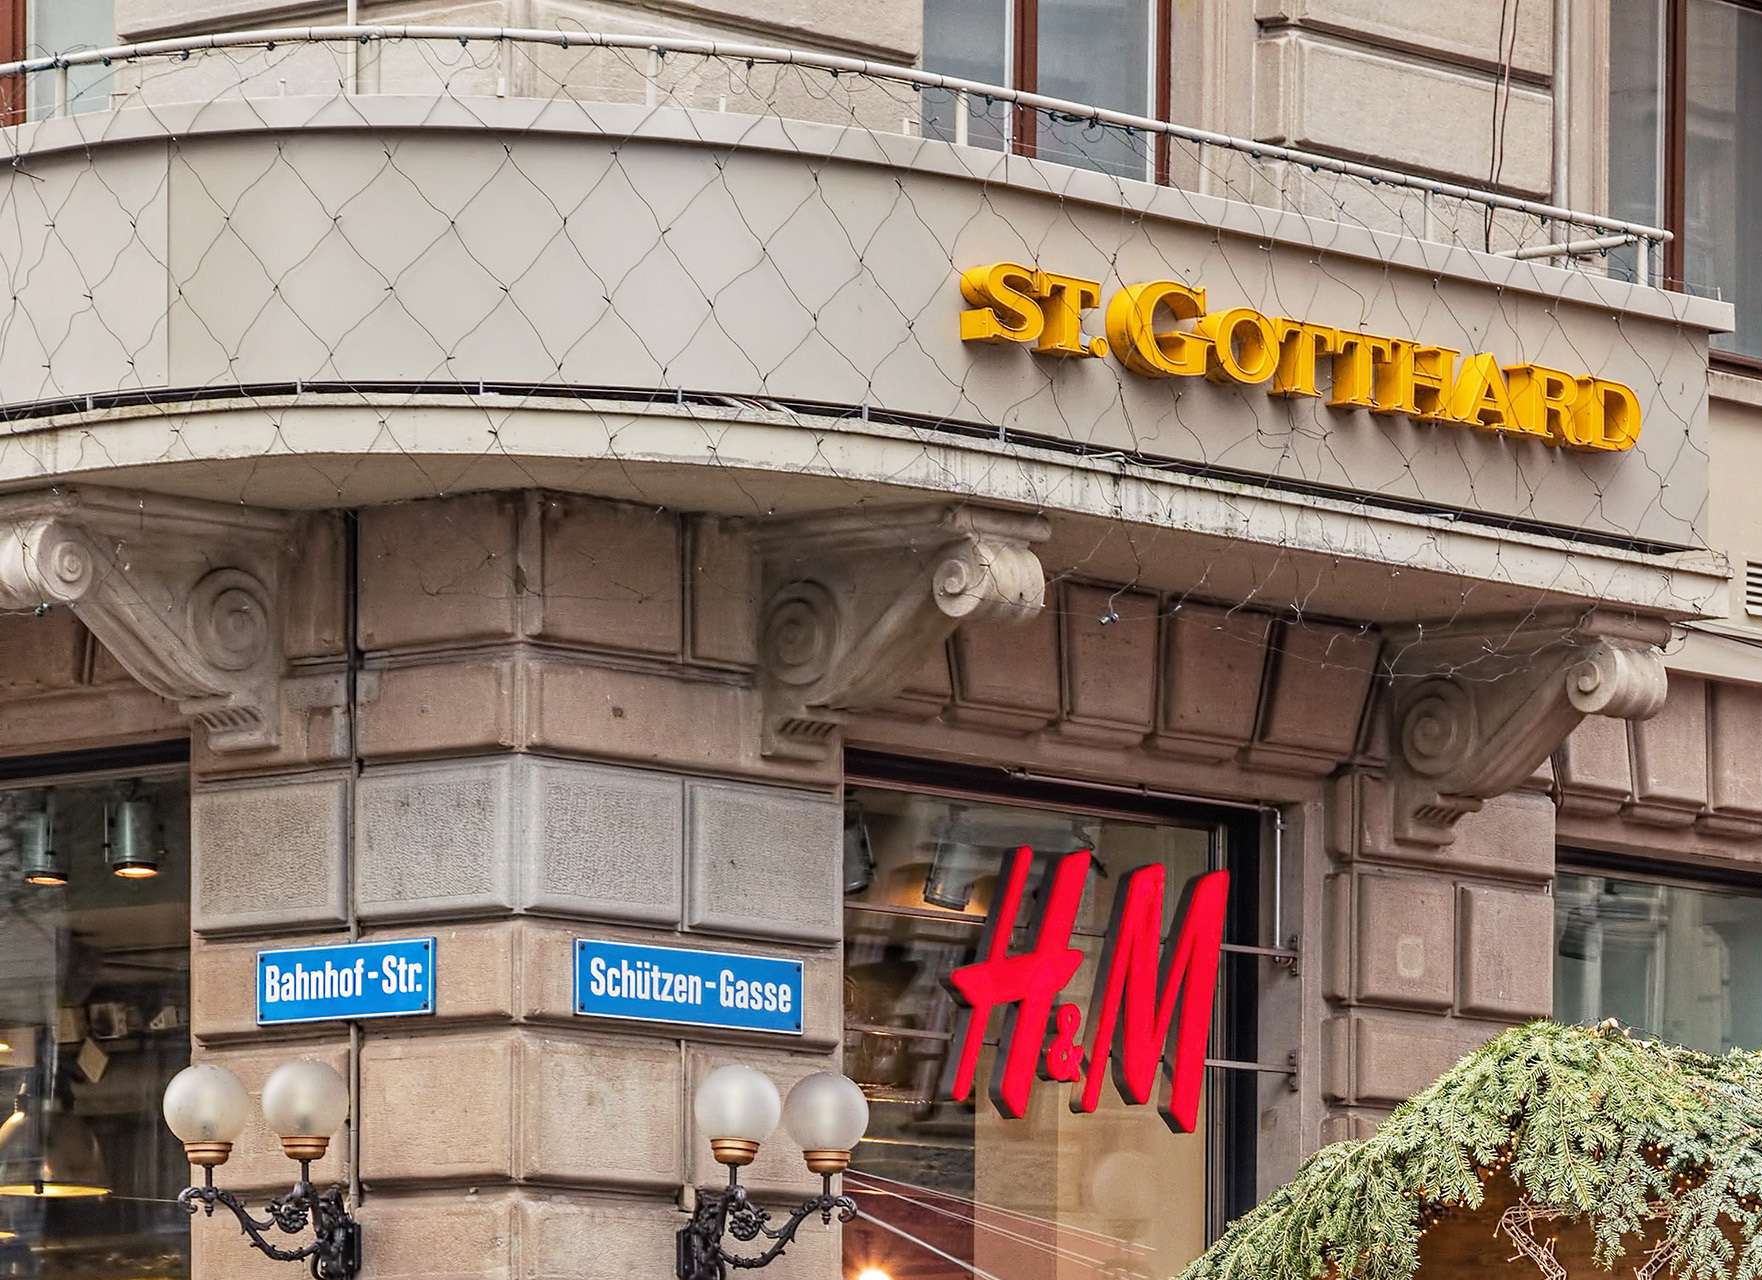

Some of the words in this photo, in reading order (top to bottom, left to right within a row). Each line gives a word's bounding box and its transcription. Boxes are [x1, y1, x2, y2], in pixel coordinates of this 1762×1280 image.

[959, 261, 1107, 359] ST.
[1105, 279, 1643, 452] GOTTHARD
[264, 957, 424, 1003] Bahnhof-Str.
[589, 956, 793, 1014] Schützen-Gasse
[944, 844, 1230, 1134] H&M
